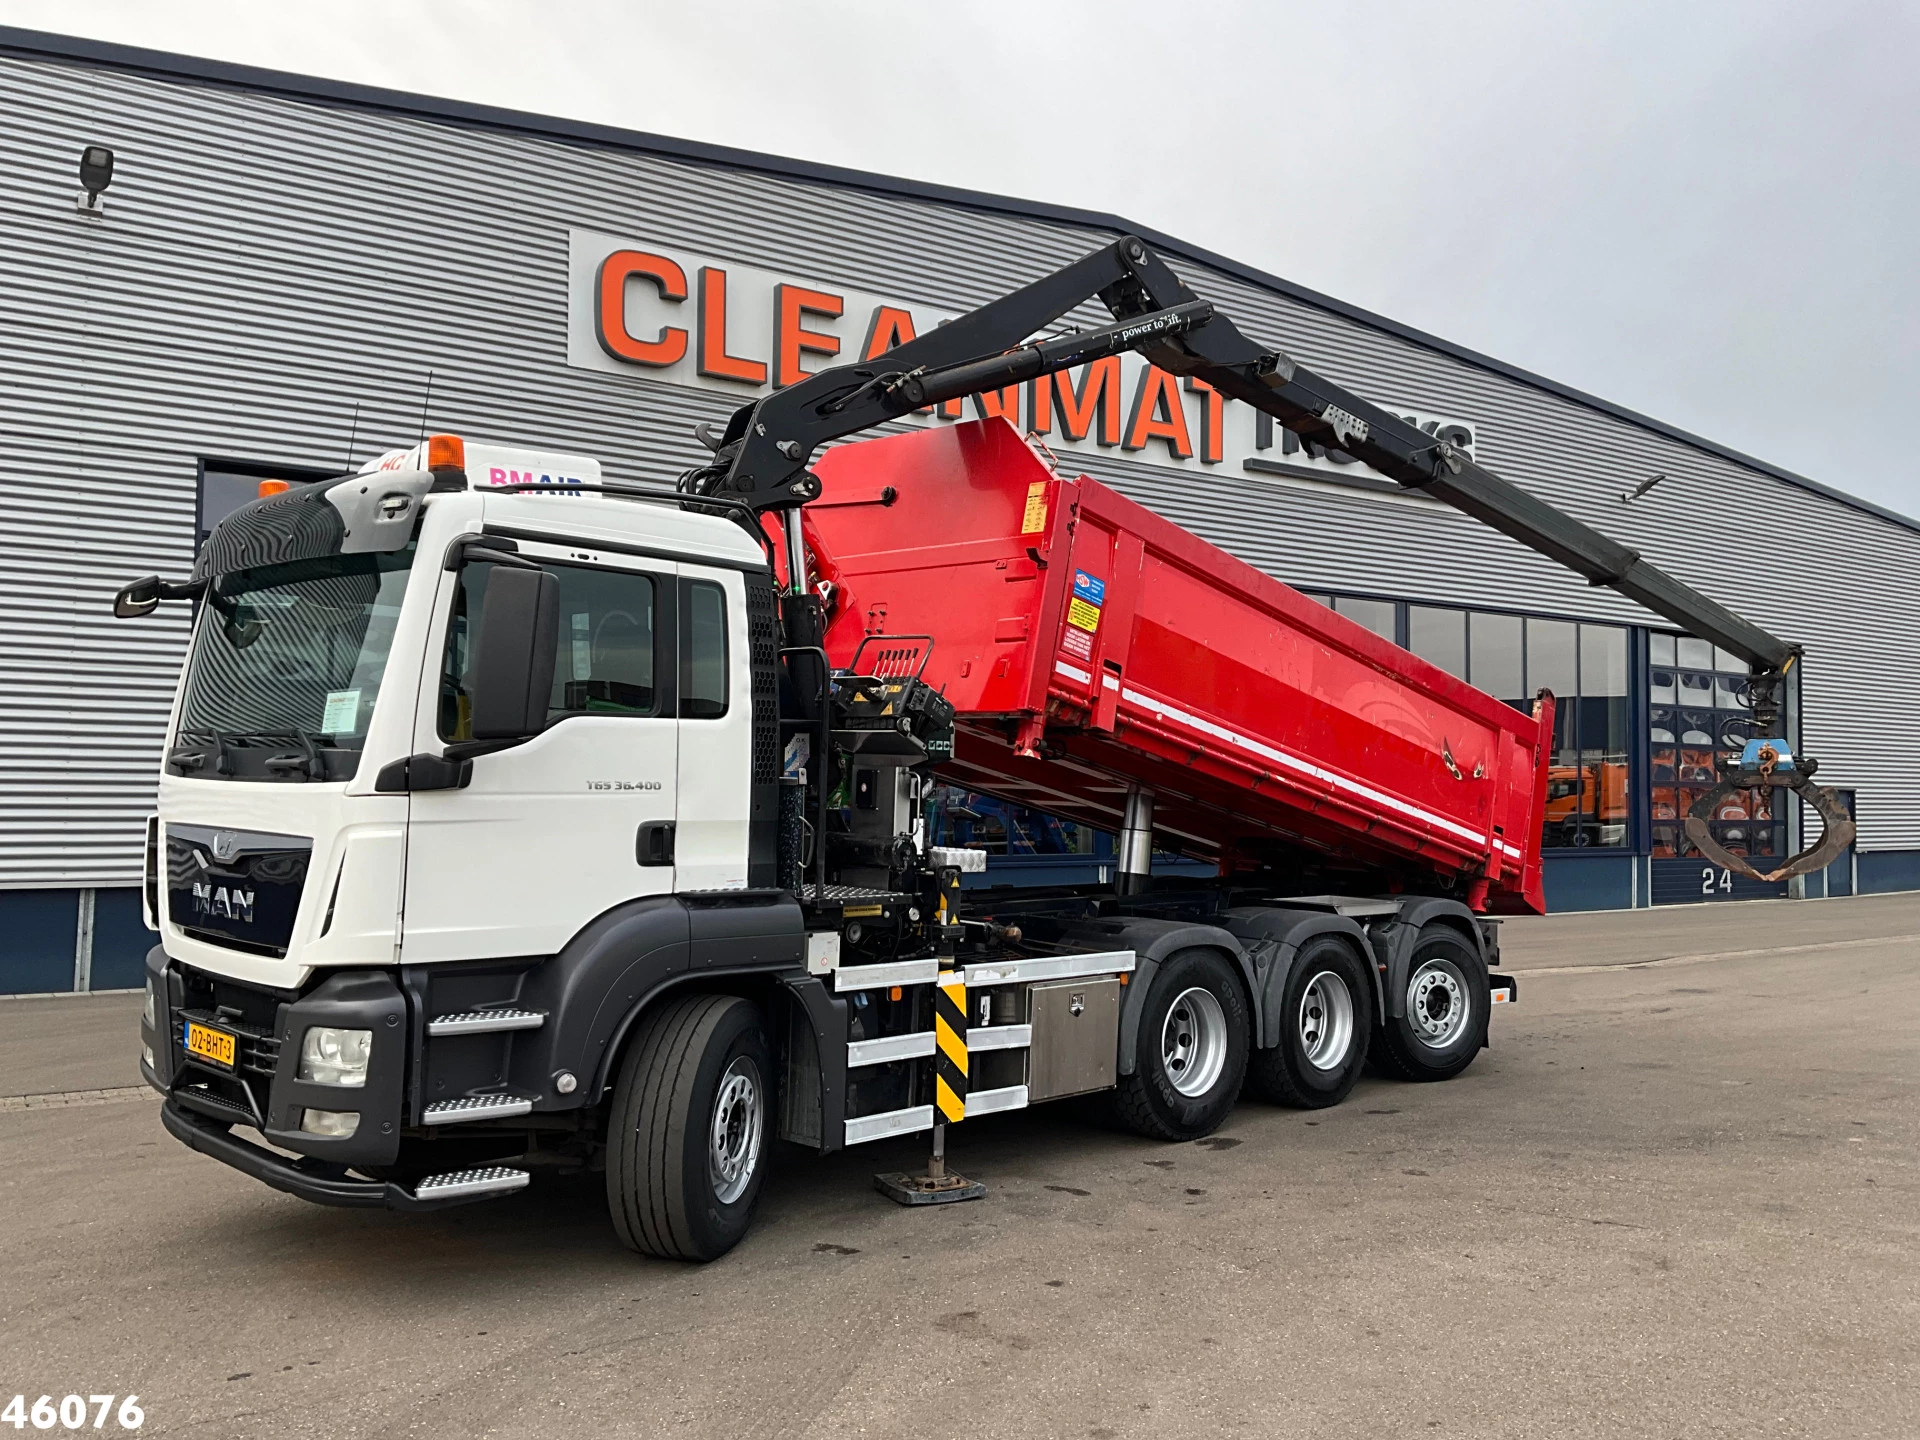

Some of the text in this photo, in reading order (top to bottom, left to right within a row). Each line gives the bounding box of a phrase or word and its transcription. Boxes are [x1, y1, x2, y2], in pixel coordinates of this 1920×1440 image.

[1122, 313, 1182, 341] power to ift.
[615, 780, 662, 790] 36.400
[1702, 867, 1732, 894] 24
[192, 882, 255, 923] MAN
[191, 1028, 232, 1060] 02-BHT-3
